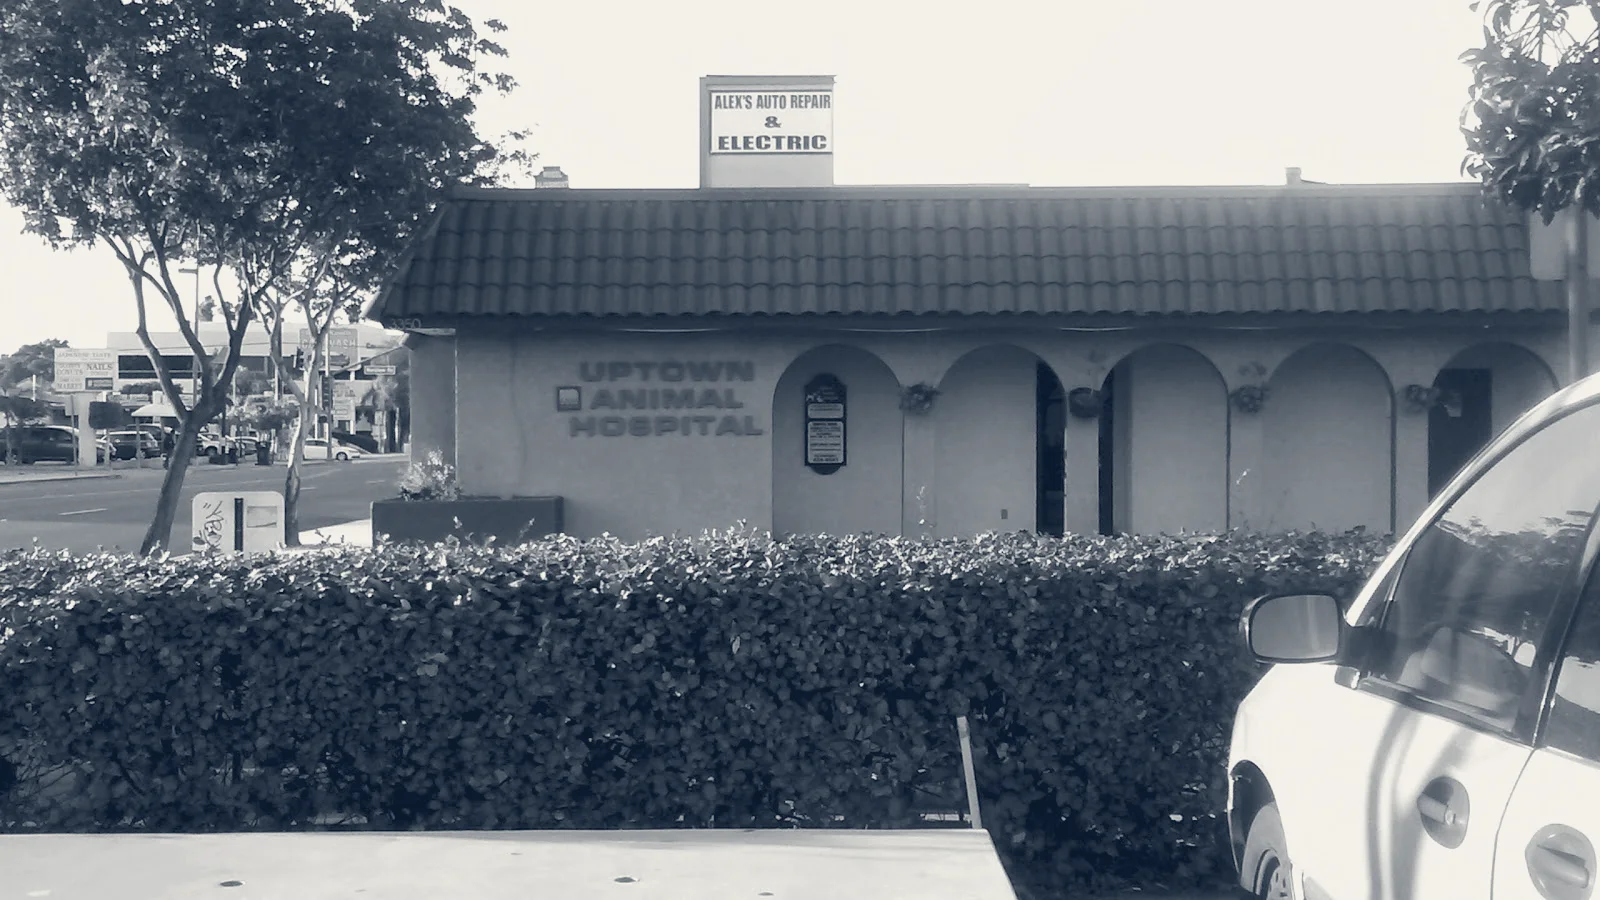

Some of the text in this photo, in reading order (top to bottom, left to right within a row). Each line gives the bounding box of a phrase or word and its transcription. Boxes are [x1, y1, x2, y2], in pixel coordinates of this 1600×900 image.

[714, 94, 831, 110] ALEX'S AUTO REPAIR
[764, 115, 782, 129] &
[718, 135, 827, 150] ELECTRIC
[390, 318, 421, 330] 3350
[86, 363, 113, 371] NAILS
[579, 361, 755, 383] UPTOWN
[589, 388, 745, 410] ANIMAL
[569, 415, 764, 438] HOSPITAL
